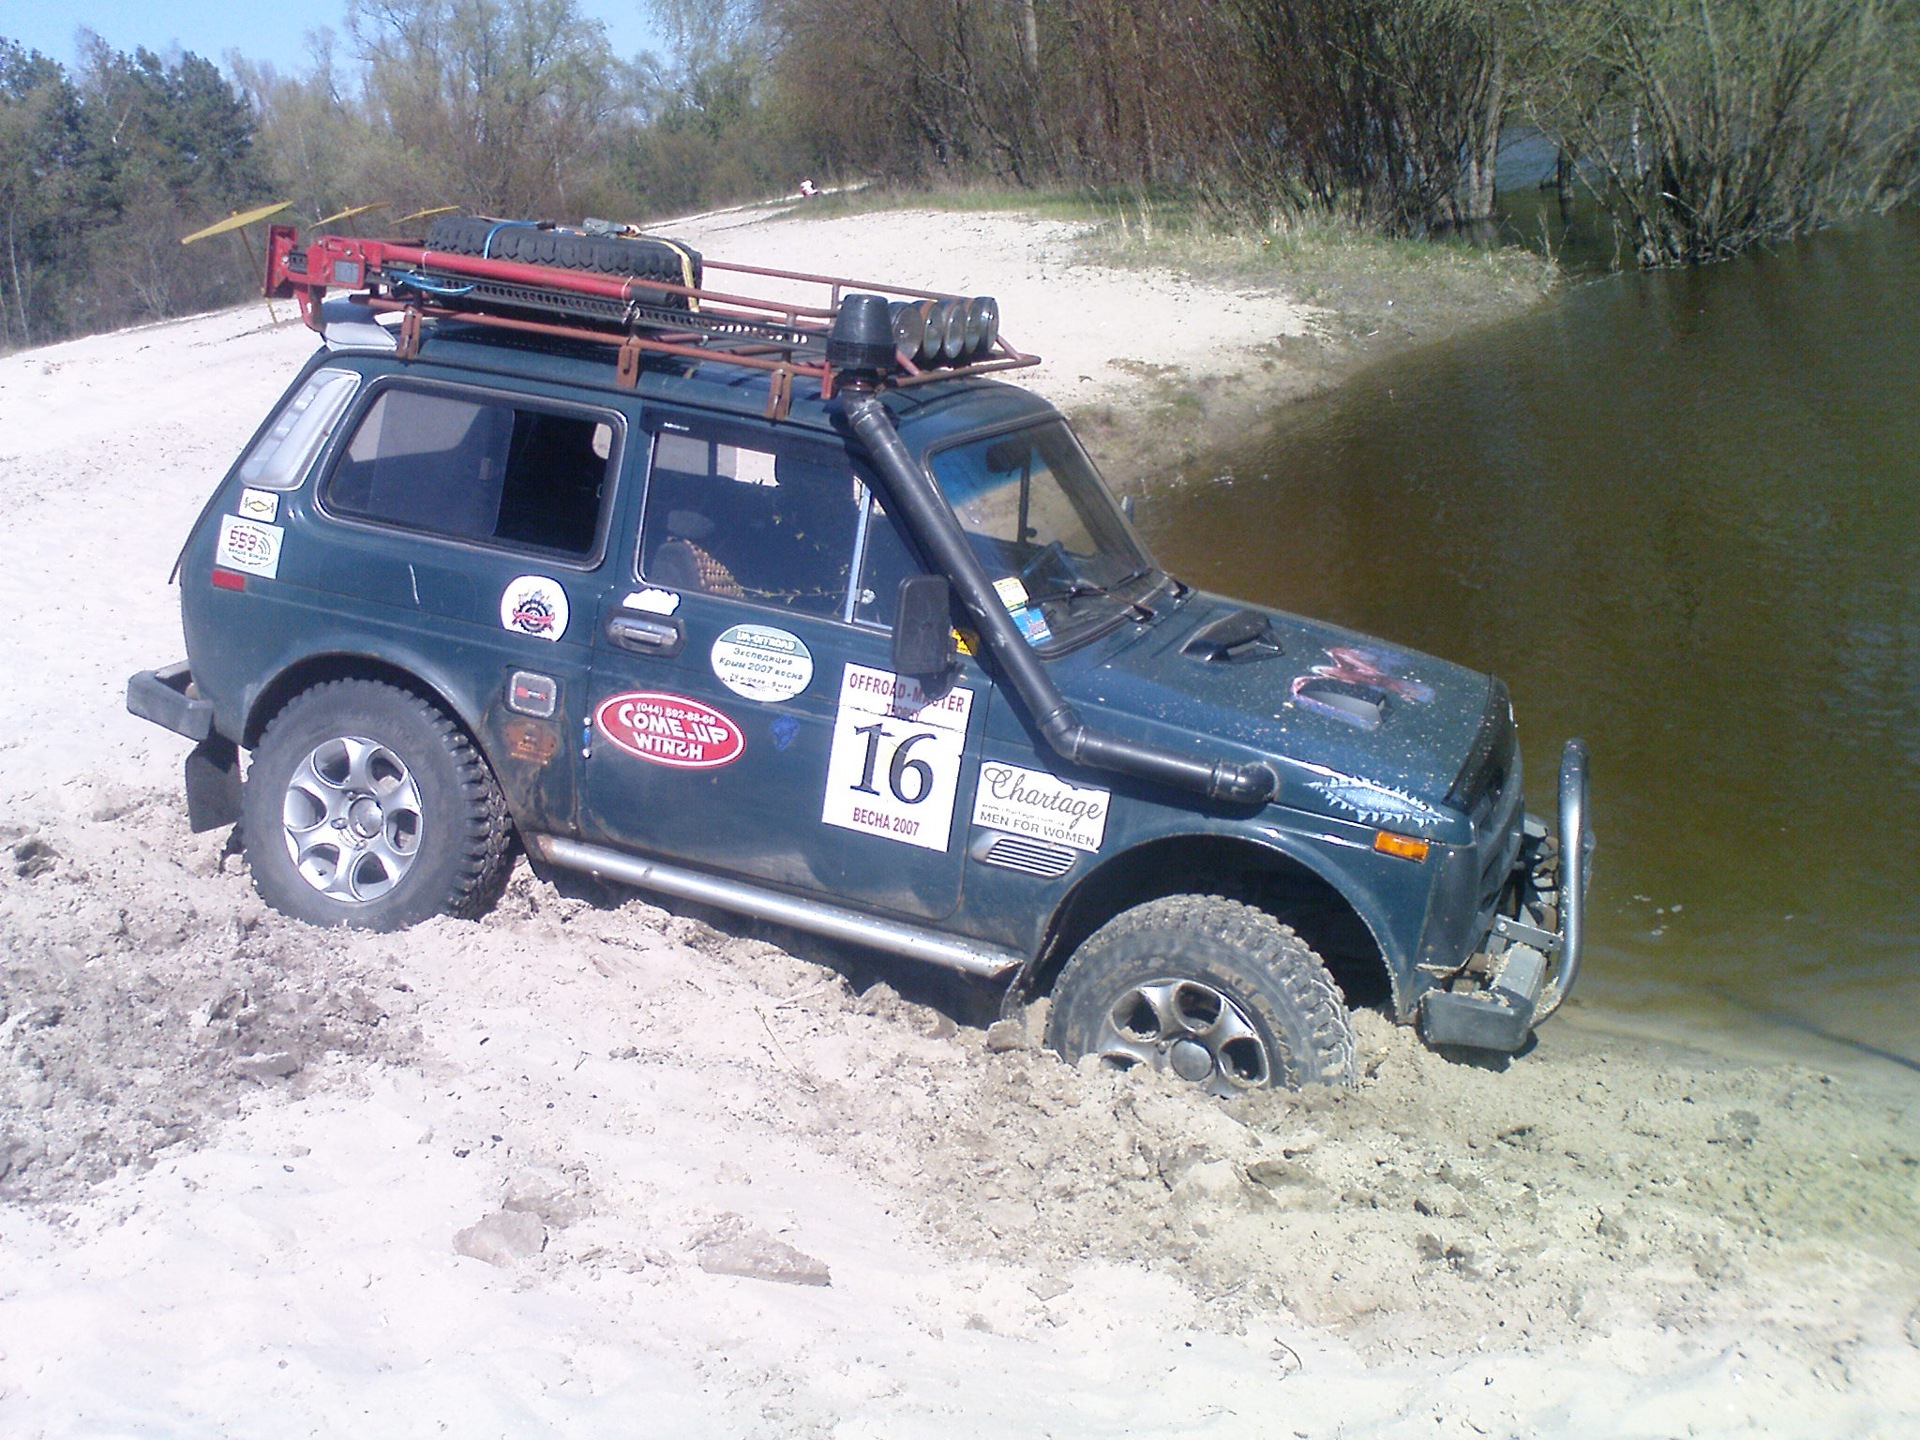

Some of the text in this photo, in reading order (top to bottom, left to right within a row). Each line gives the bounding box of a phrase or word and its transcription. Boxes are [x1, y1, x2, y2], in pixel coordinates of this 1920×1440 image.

[719, 657, 746, 669] Крым
[747, 662, 774, 674] 2007
[636, 702, 664, 717] (044)
[632, 731, 704, 760] WINCH
[850, 722, 938, 804] 16
[984, 767, 1104, 830] Chartage
[893, 817, 921, 836] 2007
[980, 811, 1096, 846] MEN FOR WOMEN
